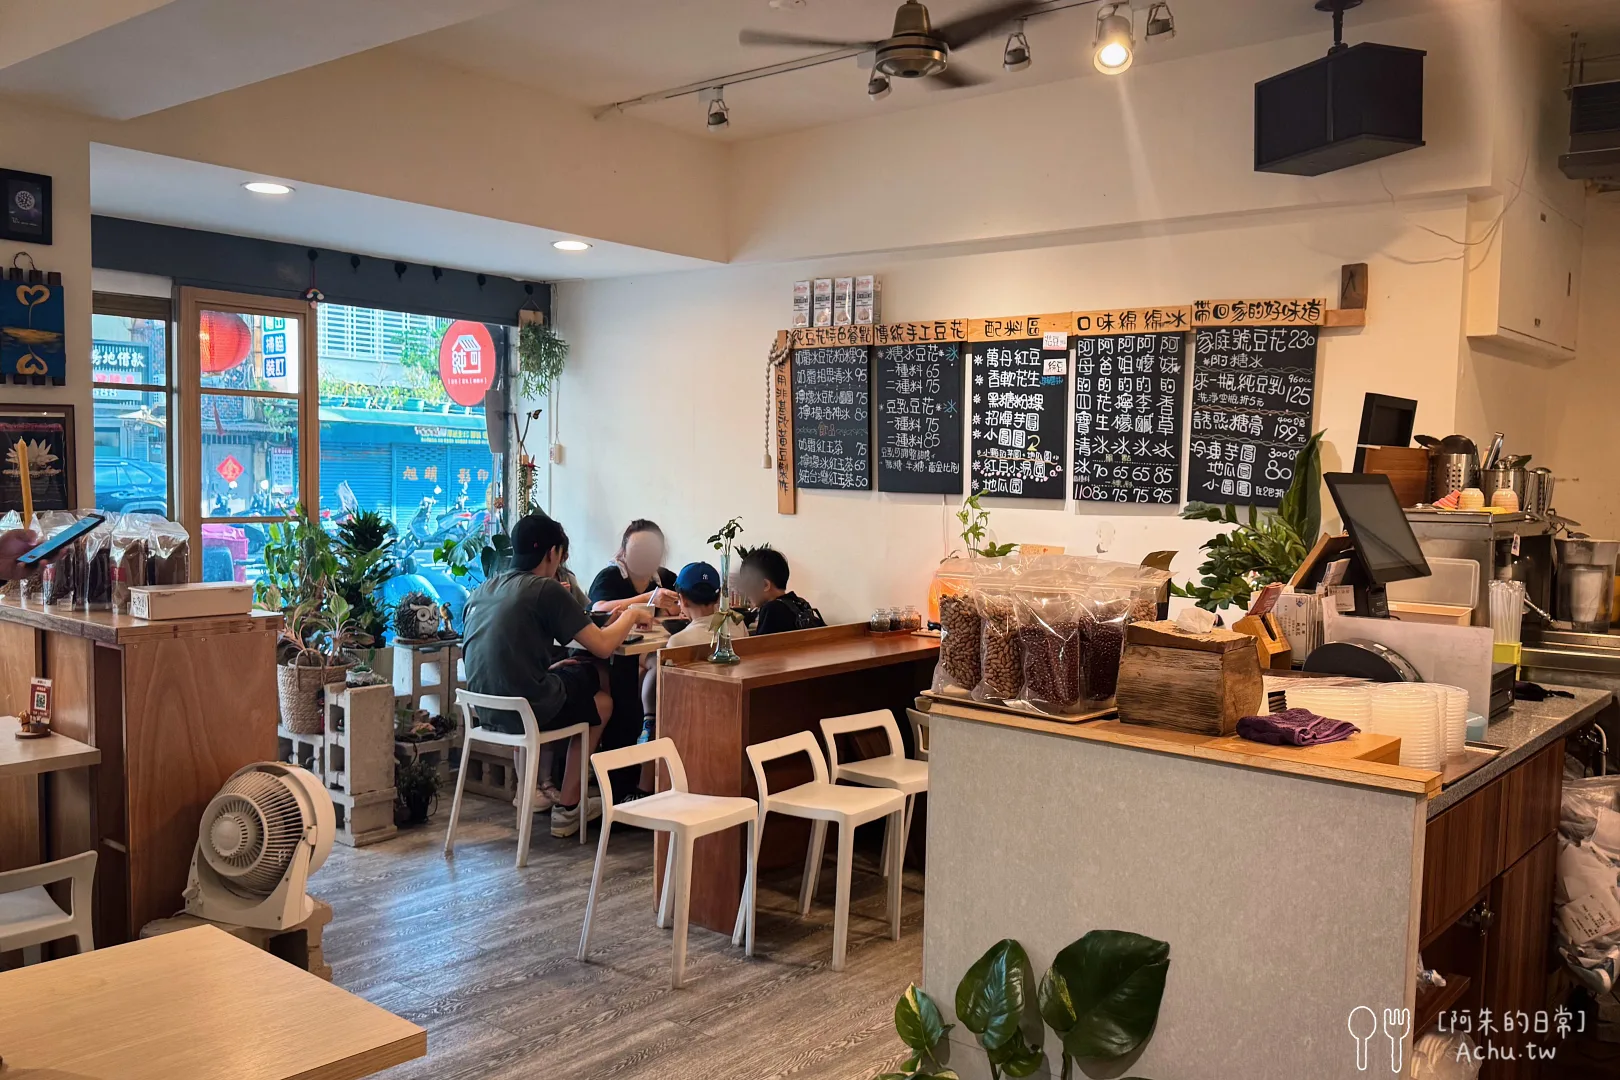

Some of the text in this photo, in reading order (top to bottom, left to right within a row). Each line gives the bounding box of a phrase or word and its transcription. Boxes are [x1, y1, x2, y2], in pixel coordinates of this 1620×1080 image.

[1077, 309, 1186, 332] 口味綿綿冰
[1194, 299, 1322, 324] 帶回家的好味道
[791, 326, 871, 347] 純豆花特色餐點
[875, 320, 965, 344] 傳統手工豆花
[984, 317, 1040, 337] 配料區
[1197, 328, 1315, 354] 家庭號豆花 230
[856, 349, 868, 364] 95
[885, 344, 939, 363] 糖水豆花
[987, 347, 1041, 368] 萬丹紅豆
[266, 358, 284, 377] 裝訂
[855, 368, 867, 382] 95
[886, 363, 940, 378] 一種料 65
[886, 379, 940, 394] 二種料 75
[987, 369, 1040, 388] 香軟花生
[1193, 373, 1286, 395] 來一瓶純豆乳
[856, 391, 868, 405] 75
[987, 391, 1045, 411] 黑糖粉粿
[1285, 386, 1312, 406] 125
[854, 407, 868, 421] 80
[886, 397, 934, 415] 豆乳豆花
[887, 416, 939, 433] 一種料 75
[985, 410, 1039, 431] 招牌芋圓
[1193, 410, 1264, 436] 誘惑糖膏
[887, 432, 940, 448] 二種料 85
[983, 428, 1025, 448] 小圓圓
[1274, 424, 1306, 443] 199 元
[855, 442, 867, 456] 75
[1190, 440, 1256, 463] 冷凍芋圓
[854, 459, 866, 471] 65
[1093, 464, 1173, 484] 70 65 65 85
[1206, 461, 1252, 480] 地瓜圓
[1265, 460, 1292, 480] 80
[855, 476, 868, 488] 50
[982, 478, 1023, 494] 地瓜圓
[1202, 479, 1252, 497] 小圓圓
[1075, 483, 1172, 503] 110 80 75 75 95
